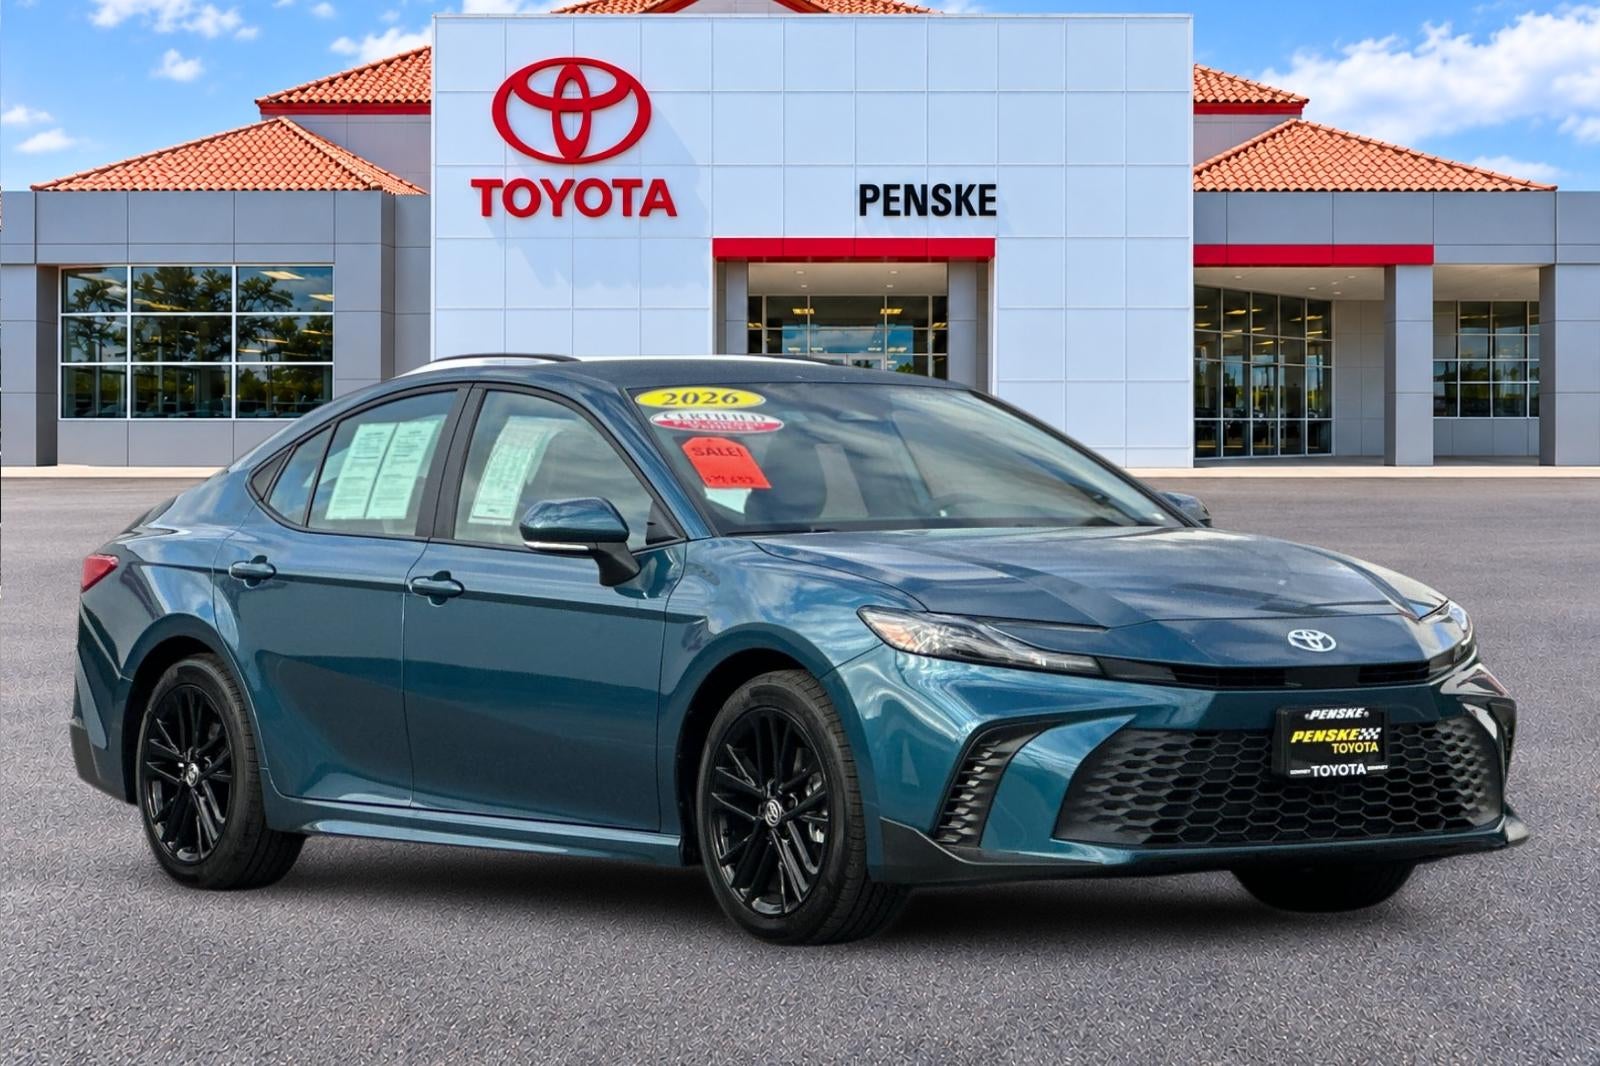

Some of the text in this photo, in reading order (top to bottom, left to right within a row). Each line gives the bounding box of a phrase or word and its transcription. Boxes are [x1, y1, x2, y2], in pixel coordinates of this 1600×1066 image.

[471, 178, 677, 218] TOYOTA
[859, 183, 997, 217] PENSKE
[661, 391, 739, 406] 2026
[1309, 708, 1365, 720] PENSKE
[1290, 728, 1360, 743] PENSKE
[1331, 742, 1379, 754] TOYOTA
[1311, 763, 1367, 777] TOYOTA
